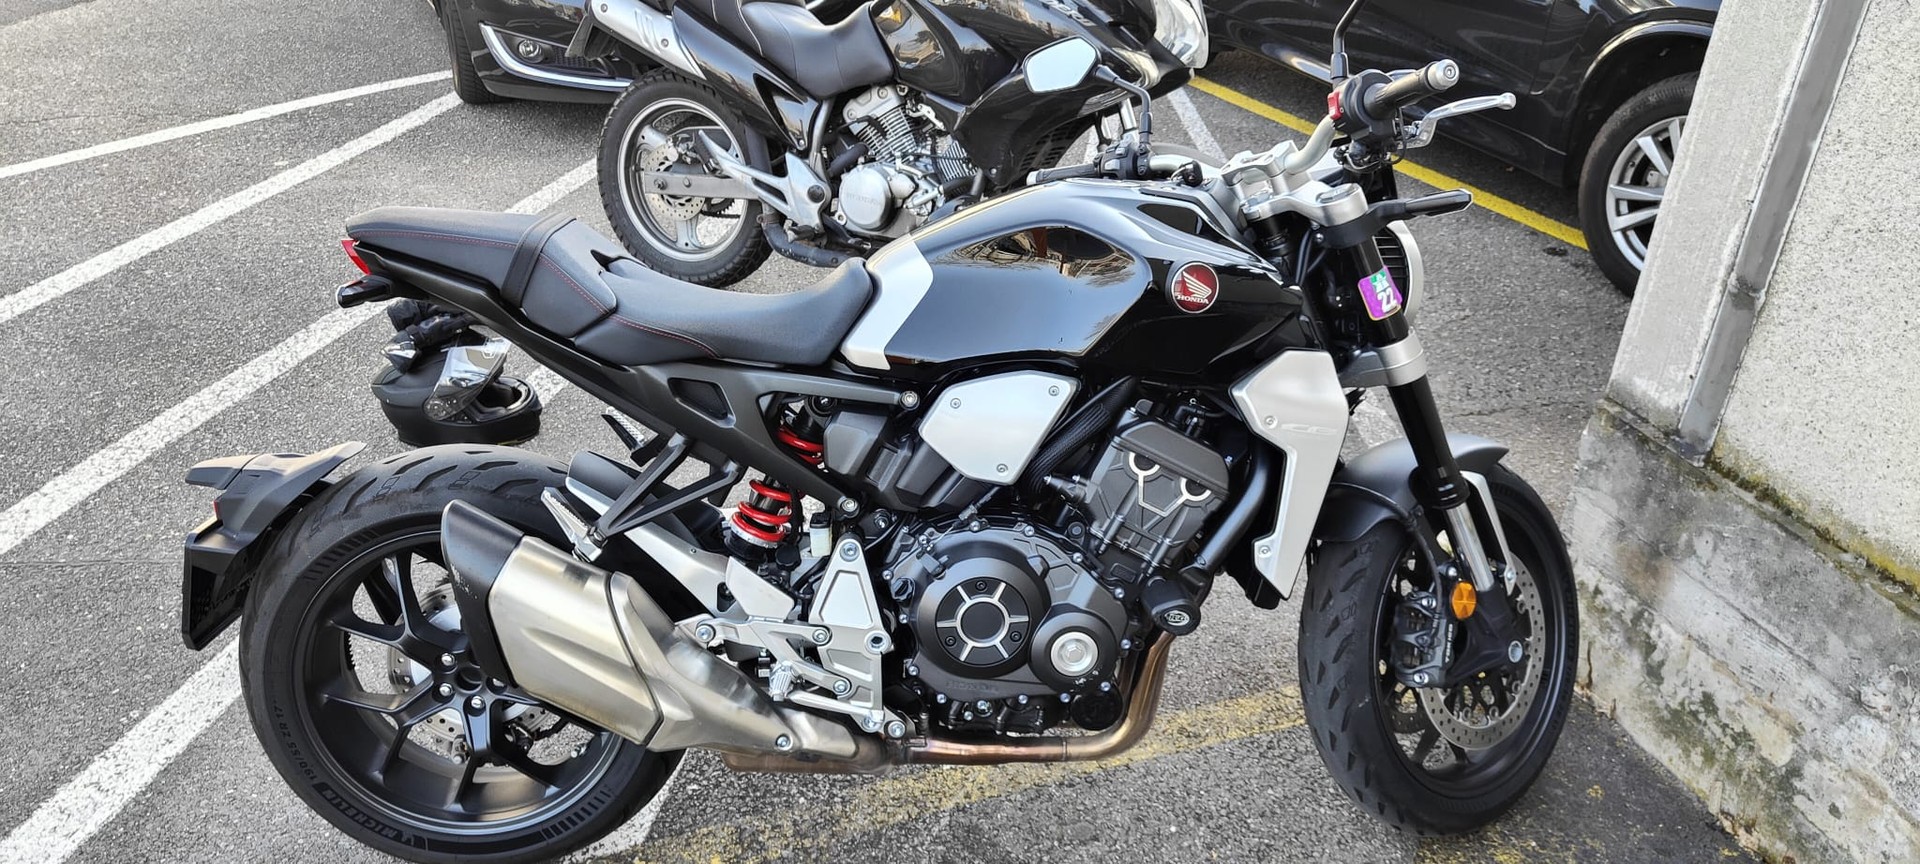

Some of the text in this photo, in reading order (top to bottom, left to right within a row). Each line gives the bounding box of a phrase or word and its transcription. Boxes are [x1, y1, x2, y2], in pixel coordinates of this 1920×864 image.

[1176, 294, 1210, 305] HONDA
[1377, 286, 1398, 313] 22
[321, 786, 399, 838] MICHELIN
